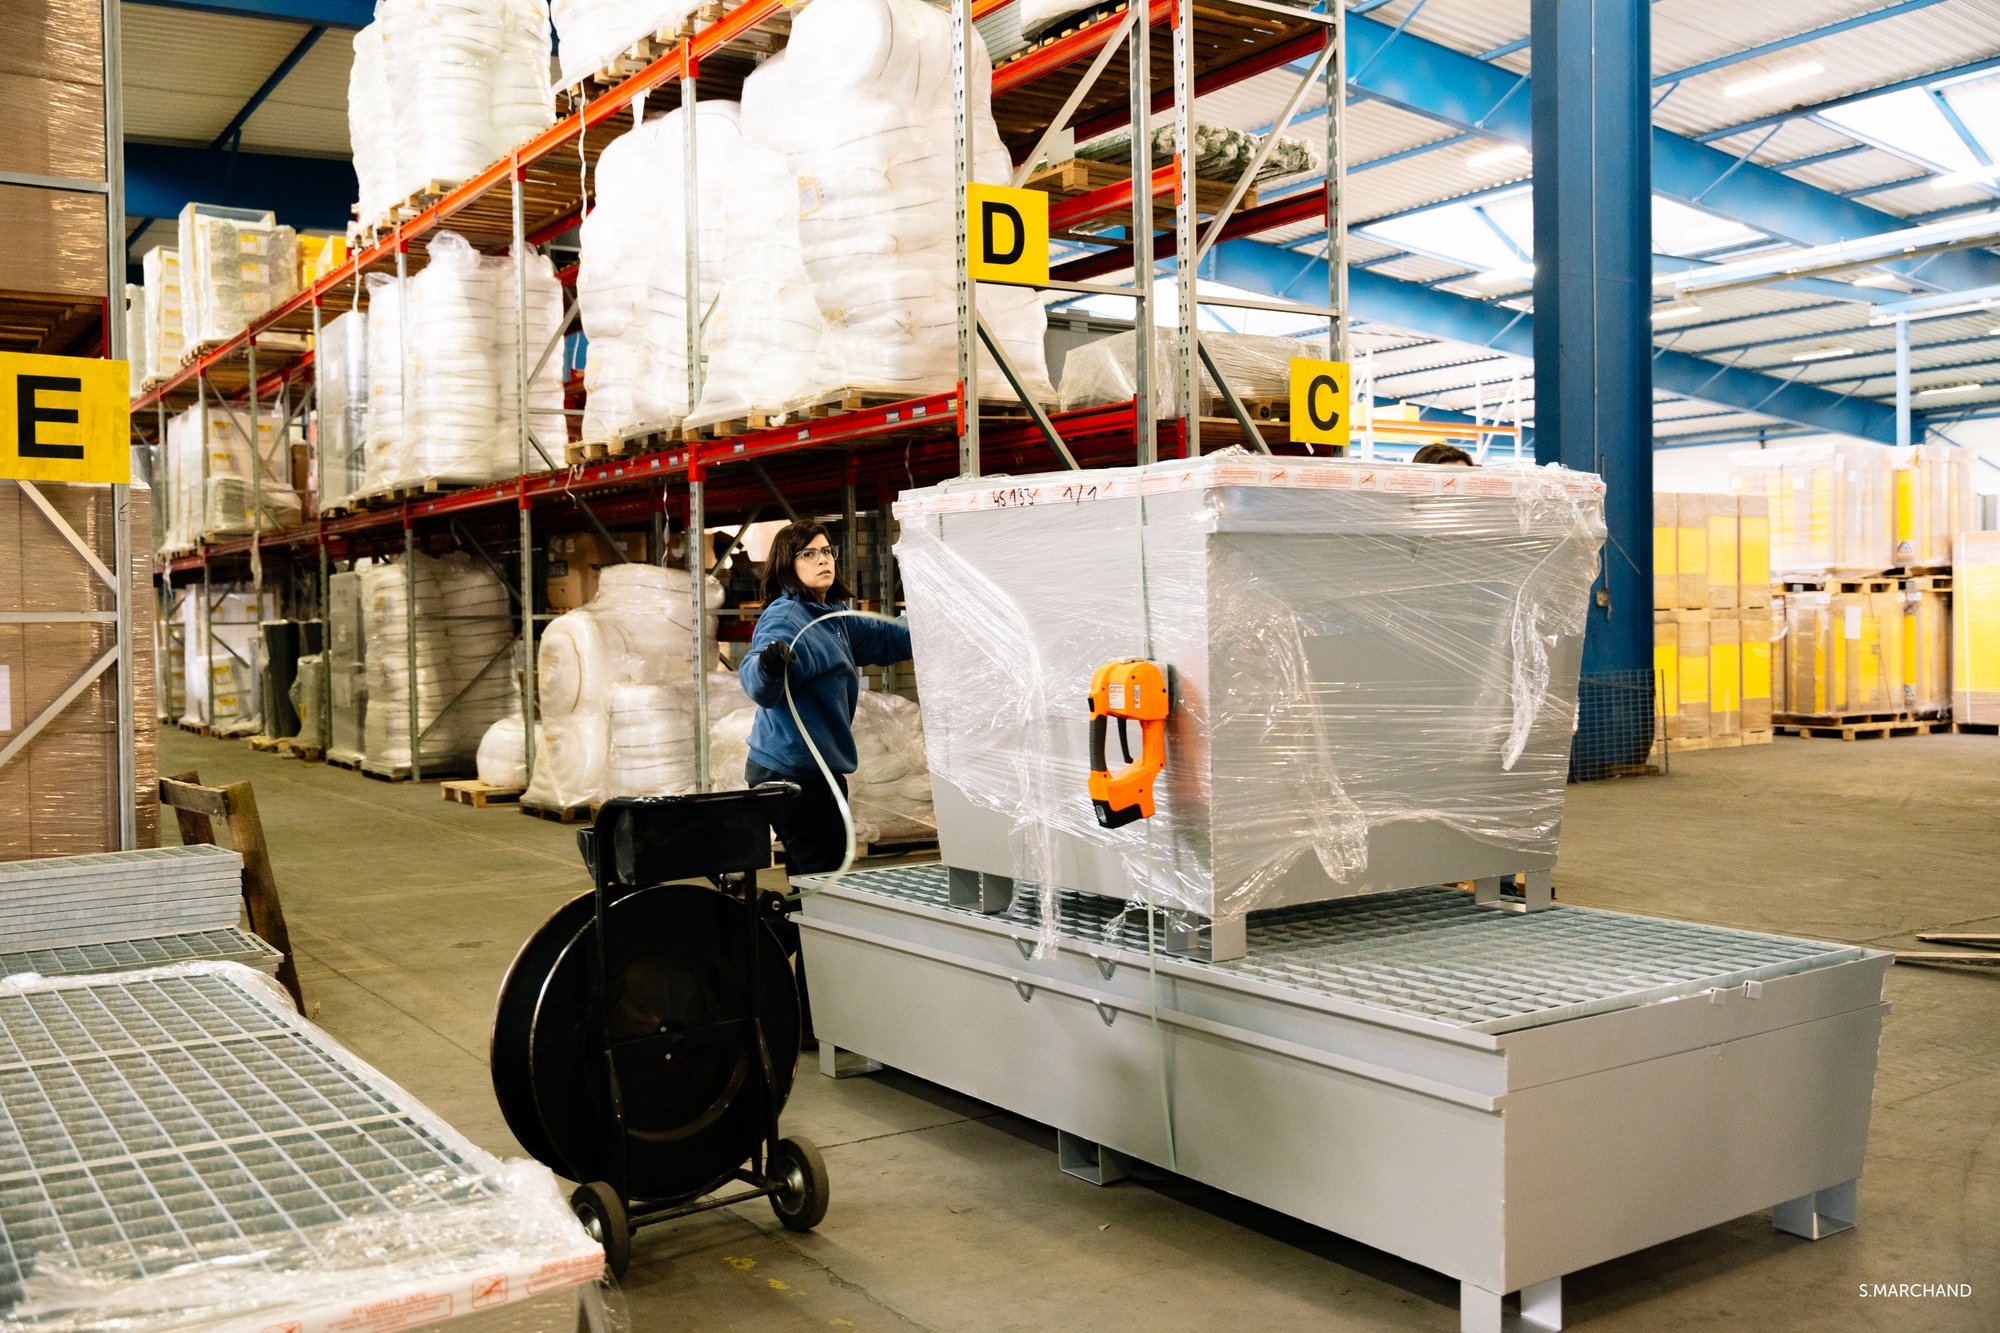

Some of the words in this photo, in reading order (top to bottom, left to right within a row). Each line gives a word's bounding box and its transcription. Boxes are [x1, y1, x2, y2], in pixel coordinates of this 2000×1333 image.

[982, 201, 1025, 265] D
[16, 374, 84, 460] E
[1307, 374, 1340, 431] C
